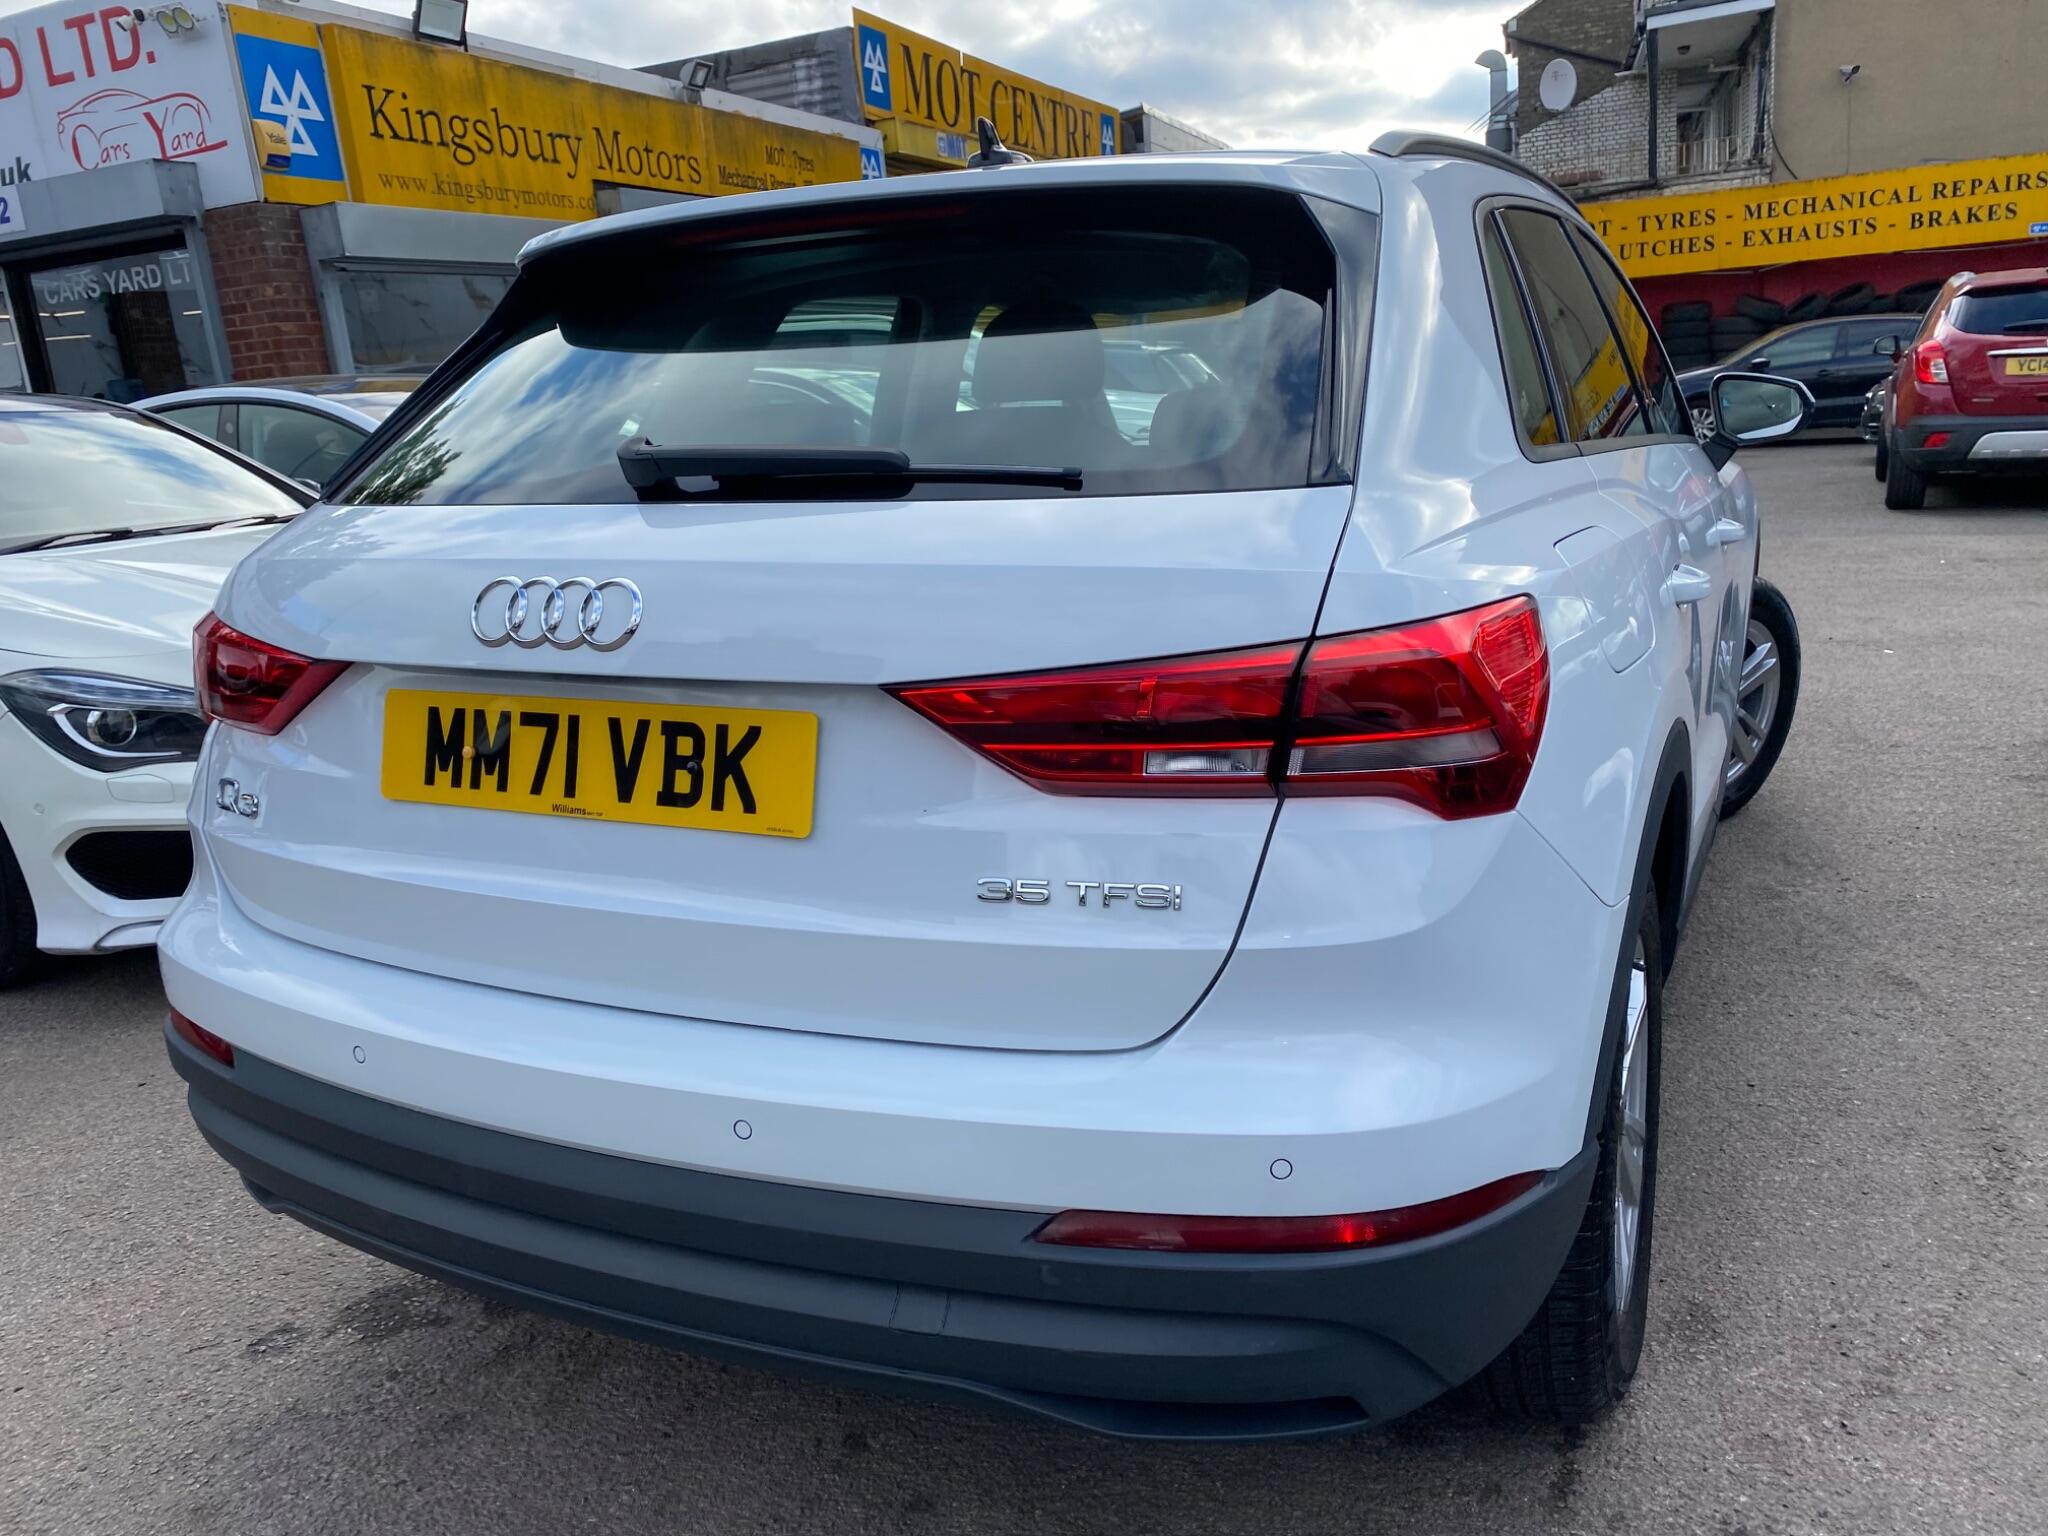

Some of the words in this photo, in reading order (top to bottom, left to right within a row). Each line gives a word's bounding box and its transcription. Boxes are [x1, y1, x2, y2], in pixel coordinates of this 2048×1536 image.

[37, 6, 156, 87] LTD.
[900, 43, 981, 135] MOT
[989, 80, 1093, 158] CENTRE
[71, 123, 131, 171] Cars
[361, 84, 582, 179] Kingsbury
[592, 127, 701, 184] Motors
[1614, 235, 1716, 261] UTCHES
[1743, 217, 1878, 248] EXHAUSTS
[1910, 202, 2018, 230] BRAKES
[1638, 208, 1717, 233] TYRES
[1743, 185, 1923, 221] MECHANICAL
[1932, 171, 2048, 200] REPAIRS
[44, 274, 101, 305] CARS
[104, 264, 162, 294] YARD
[424, 706, 580, 799] MM71
[607, 716, 762, 814] VBK
[216, 777, 260, 820] Q3
[552, 804, 586, 816] Williams
[977, 877, 1050, 904] 35
[1065, 881, 1184, 911] TFSI
